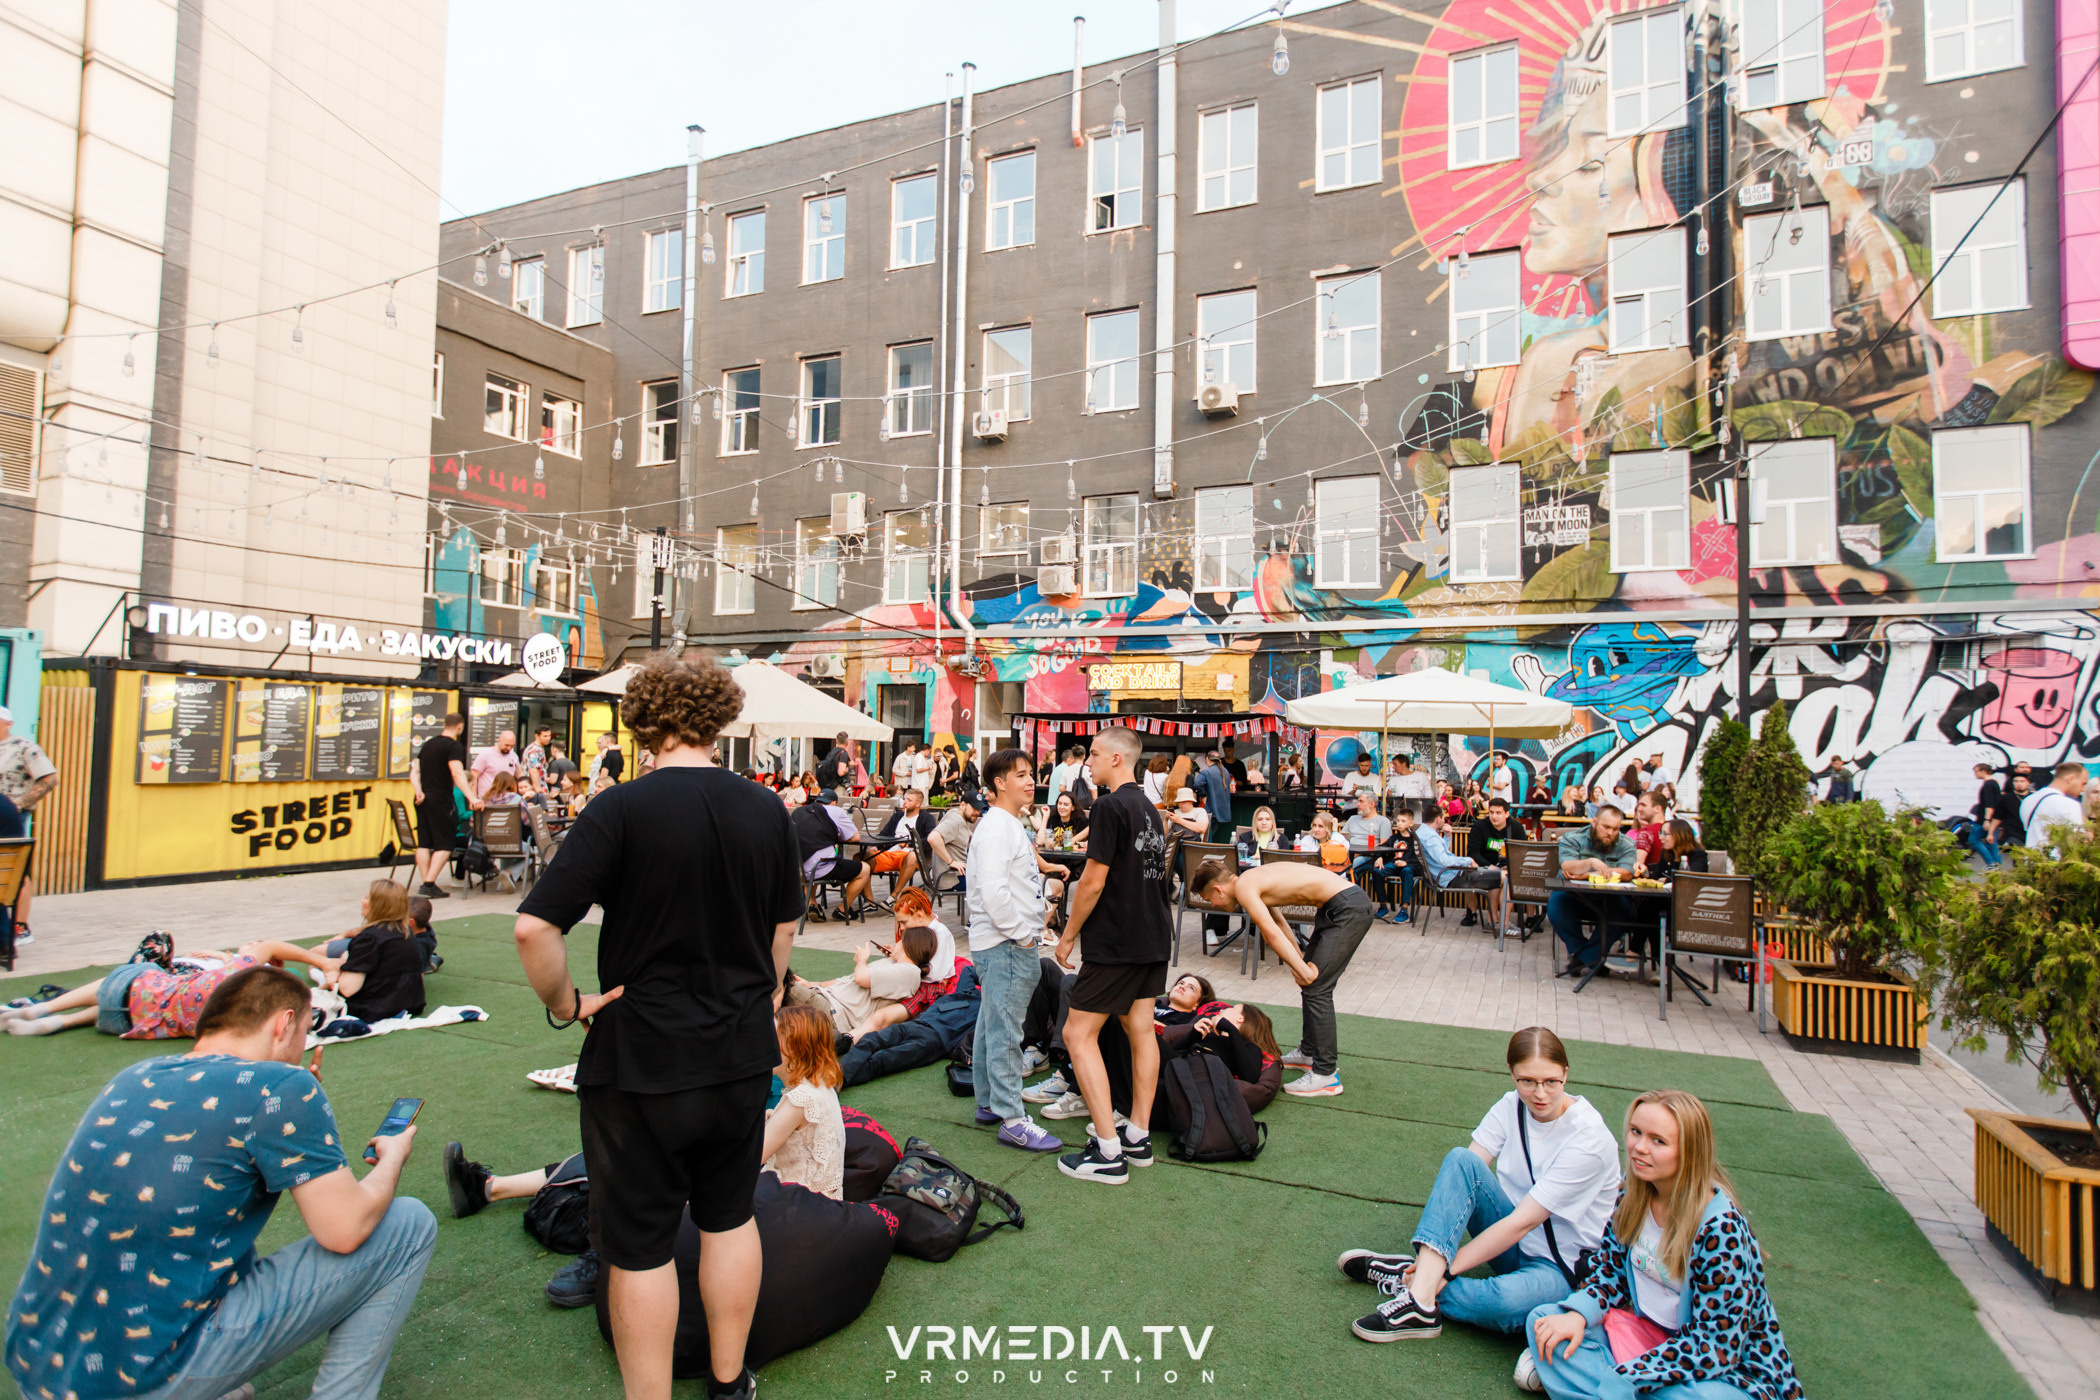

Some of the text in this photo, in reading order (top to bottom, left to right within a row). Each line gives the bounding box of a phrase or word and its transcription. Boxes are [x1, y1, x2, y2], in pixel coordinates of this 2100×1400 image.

[1778, 303, 1880, 361] WEST
[1526, 506, 1588, 521] MAN ON THE
[1557, 518, 1588, 531] MOON
[148, 603, 512, 666] ПИВО ЕДА ЗАКУСКИ
[527, 645, 562, 663] STREET
[533, 655, 558, 669] FOOD
[1089, 663, 1180, 677] COCKTAILS
[1088, 674, 1180, 690] AND DRINK
[231, 786, 372, 835] STREET
[249, 816, 353, 857] FOOD
[1691, 911, 1731, 920] БАЛТИКА
